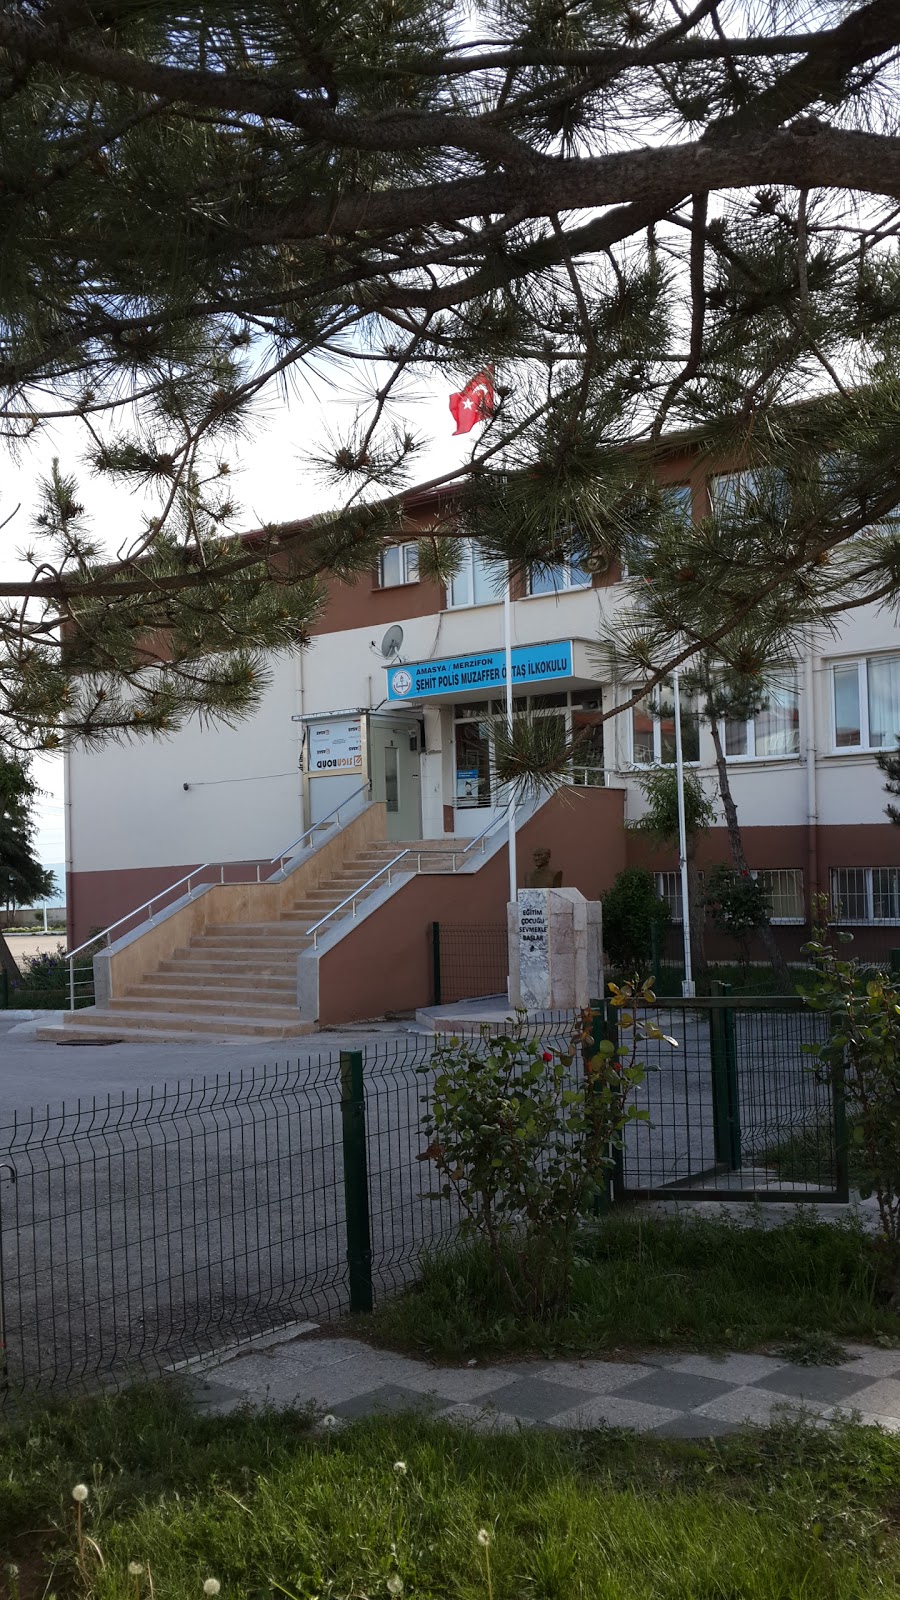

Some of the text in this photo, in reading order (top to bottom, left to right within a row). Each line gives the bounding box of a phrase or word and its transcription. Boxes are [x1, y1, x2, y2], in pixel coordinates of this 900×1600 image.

[416, 665, 447, 675] AMASYA
[453, 658, 493, 670] MERZİFON
[416, 675, 436, 693] ŞEHİT
[438, 673, 459, 687] POLİS
[461, 668, 500, 684] MUZAFFER
[502, 663, 526, 680] ÖTAŞ
[528, 658, 567, 675] İLKOKULU
